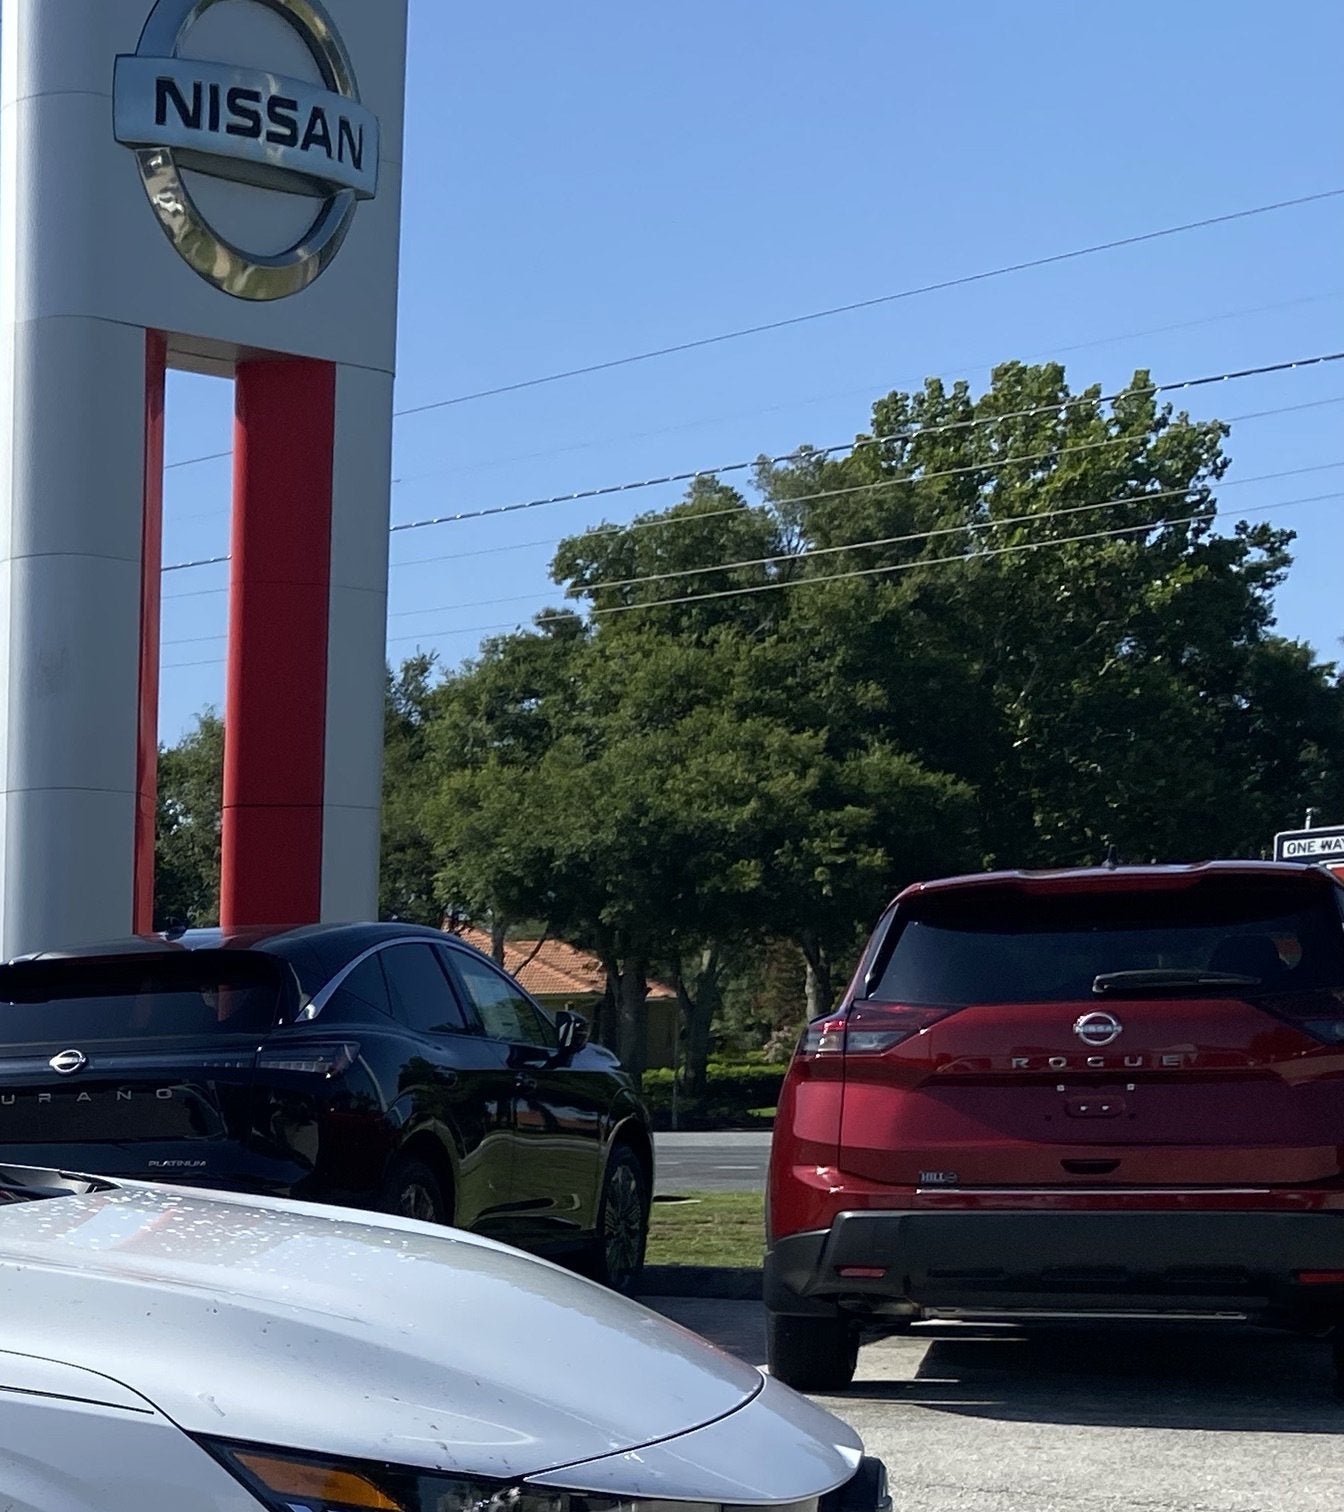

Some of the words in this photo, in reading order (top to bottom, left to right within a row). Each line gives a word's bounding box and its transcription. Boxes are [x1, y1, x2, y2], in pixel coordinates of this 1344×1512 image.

[154, 76, 364, 171] NISSAN
[1286, 841, 1316, 855] ONE
[1011, 1055, 1181, 1069] ROGUE
